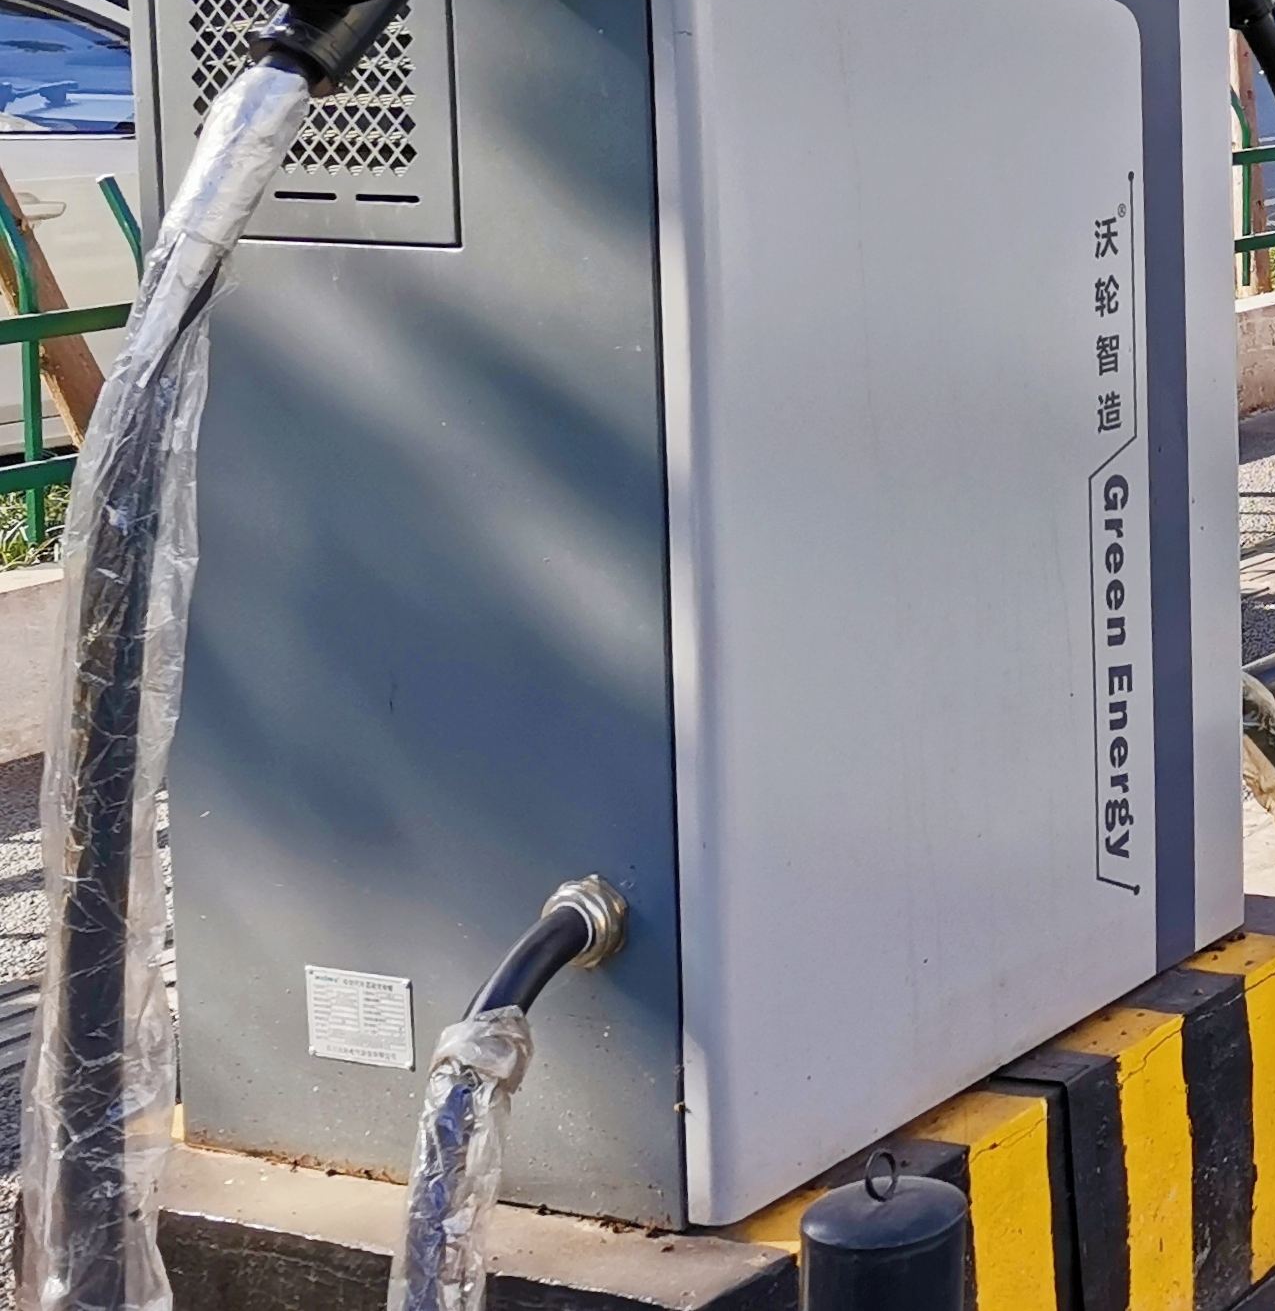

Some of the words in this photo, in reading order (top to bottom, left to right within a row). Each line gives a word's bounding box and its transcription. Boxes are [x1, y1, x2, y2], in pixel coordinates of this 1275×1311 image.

[1094, 216, 1122, 434] 沃轮智造
[1104, 474, 1130, 647] Green
[1104, 663, 1134, 859] Energy
